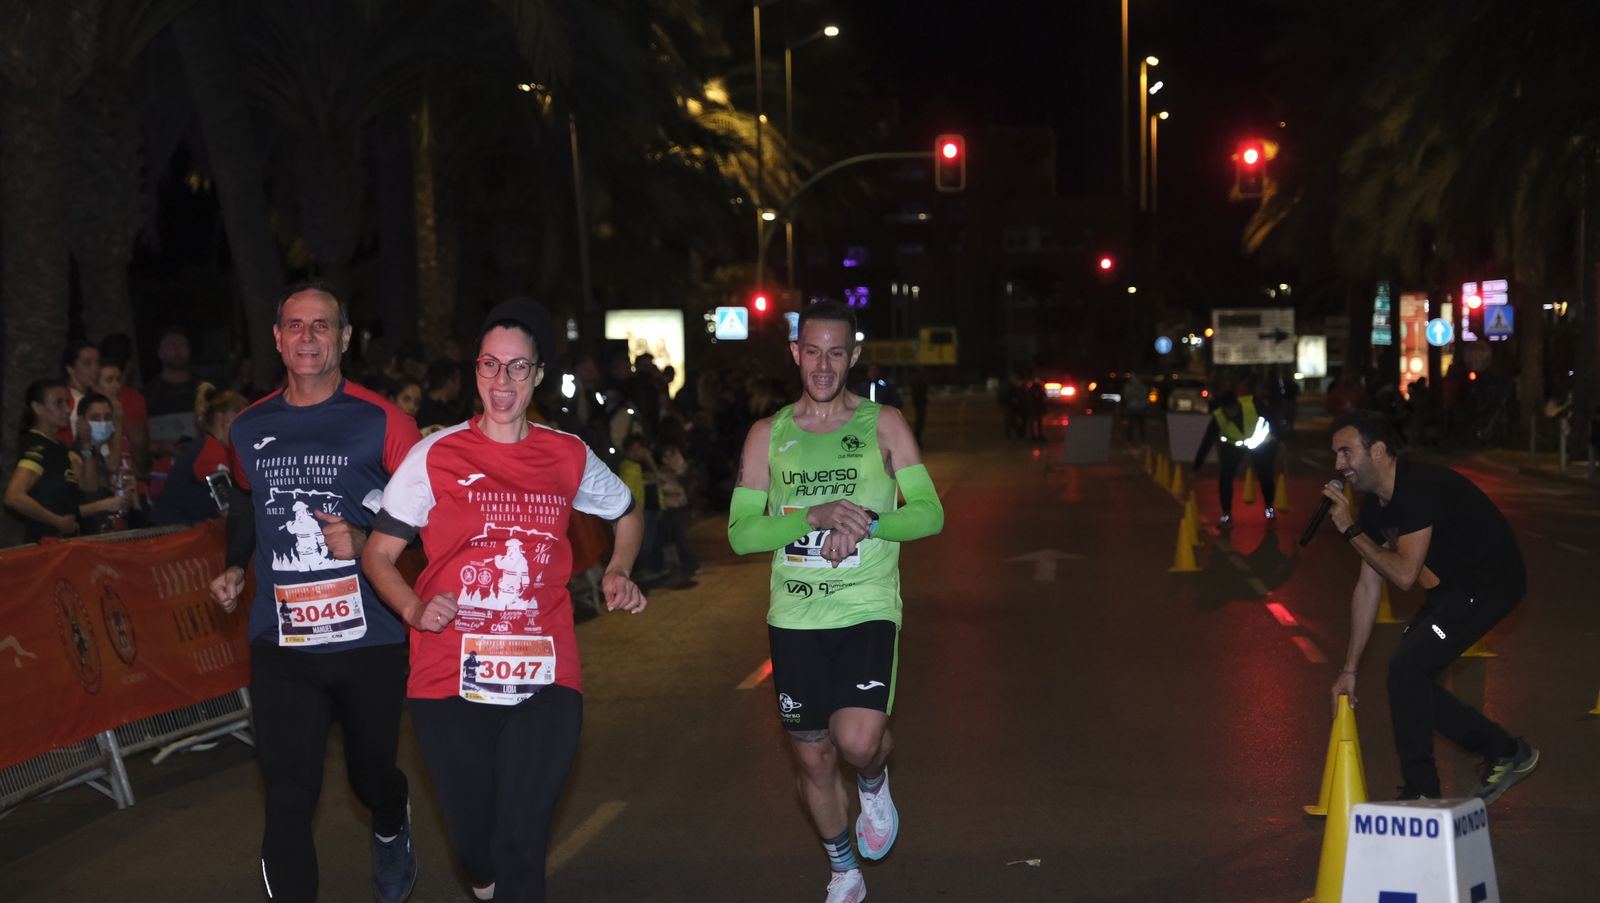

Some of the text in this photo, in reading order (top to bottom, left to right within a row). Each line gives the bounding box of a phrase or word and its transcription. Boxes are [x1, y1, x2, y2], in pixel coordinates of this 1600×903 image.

[262, 456, 348, 468] CARRERA BOMBEROS
[264, 466, 338, 478] ALMERÍA CIUDAD
[782, 468, 858, 484] Universo
[796, 482, 856, 496] Running
[476, 492, 517, 502] CARRERA
[480, 503, 560, 516] ALMERÍA CIUDAD
[291, 600, 350, 622] 3046
[312, 625, 332, 634] MANUEL
[480, 660, 542, 680] 3047
[1354, 814, 1440, 838] MONDO
[1453, 808, 1487, 838] MONDO
